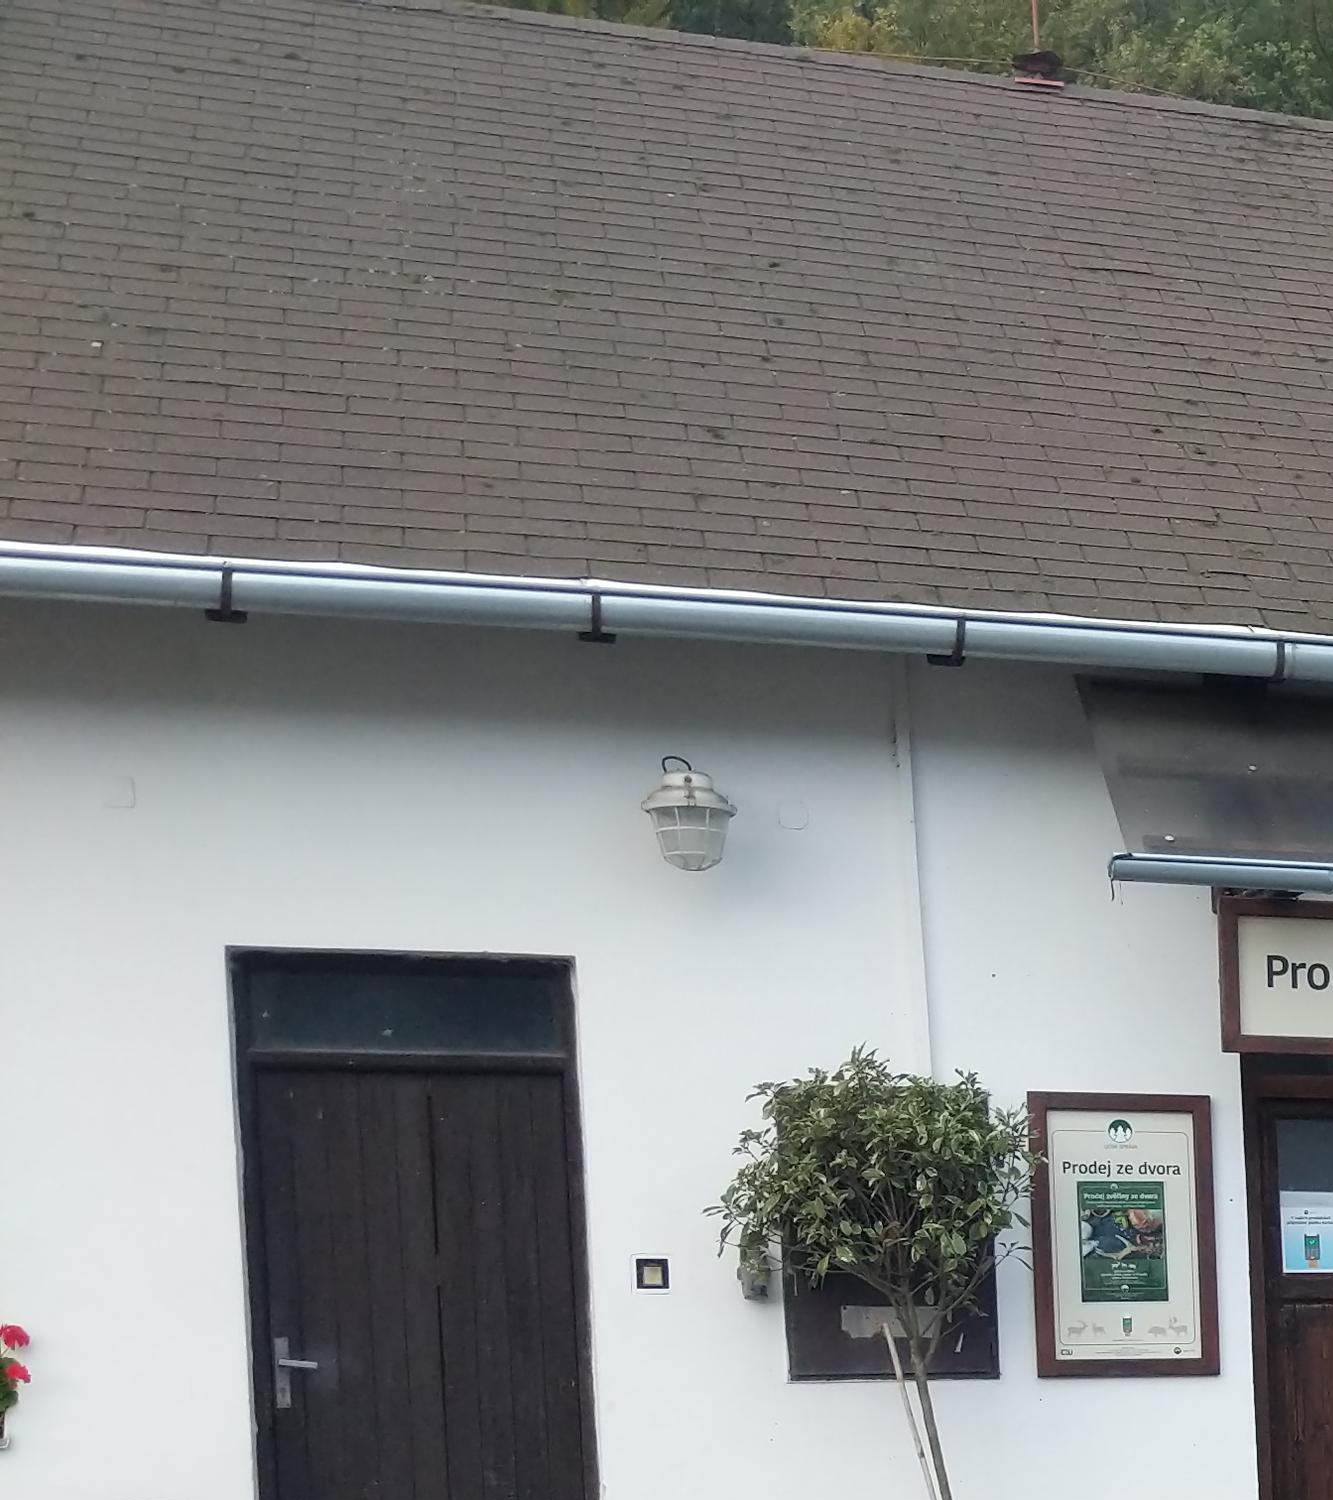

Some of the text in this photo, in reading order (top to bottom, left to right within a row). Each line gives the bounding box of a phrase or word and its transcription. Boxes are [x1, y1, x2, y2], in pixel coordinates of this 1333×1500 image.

[1062, 1160, 1181, 1177] Prodej ze dvora
